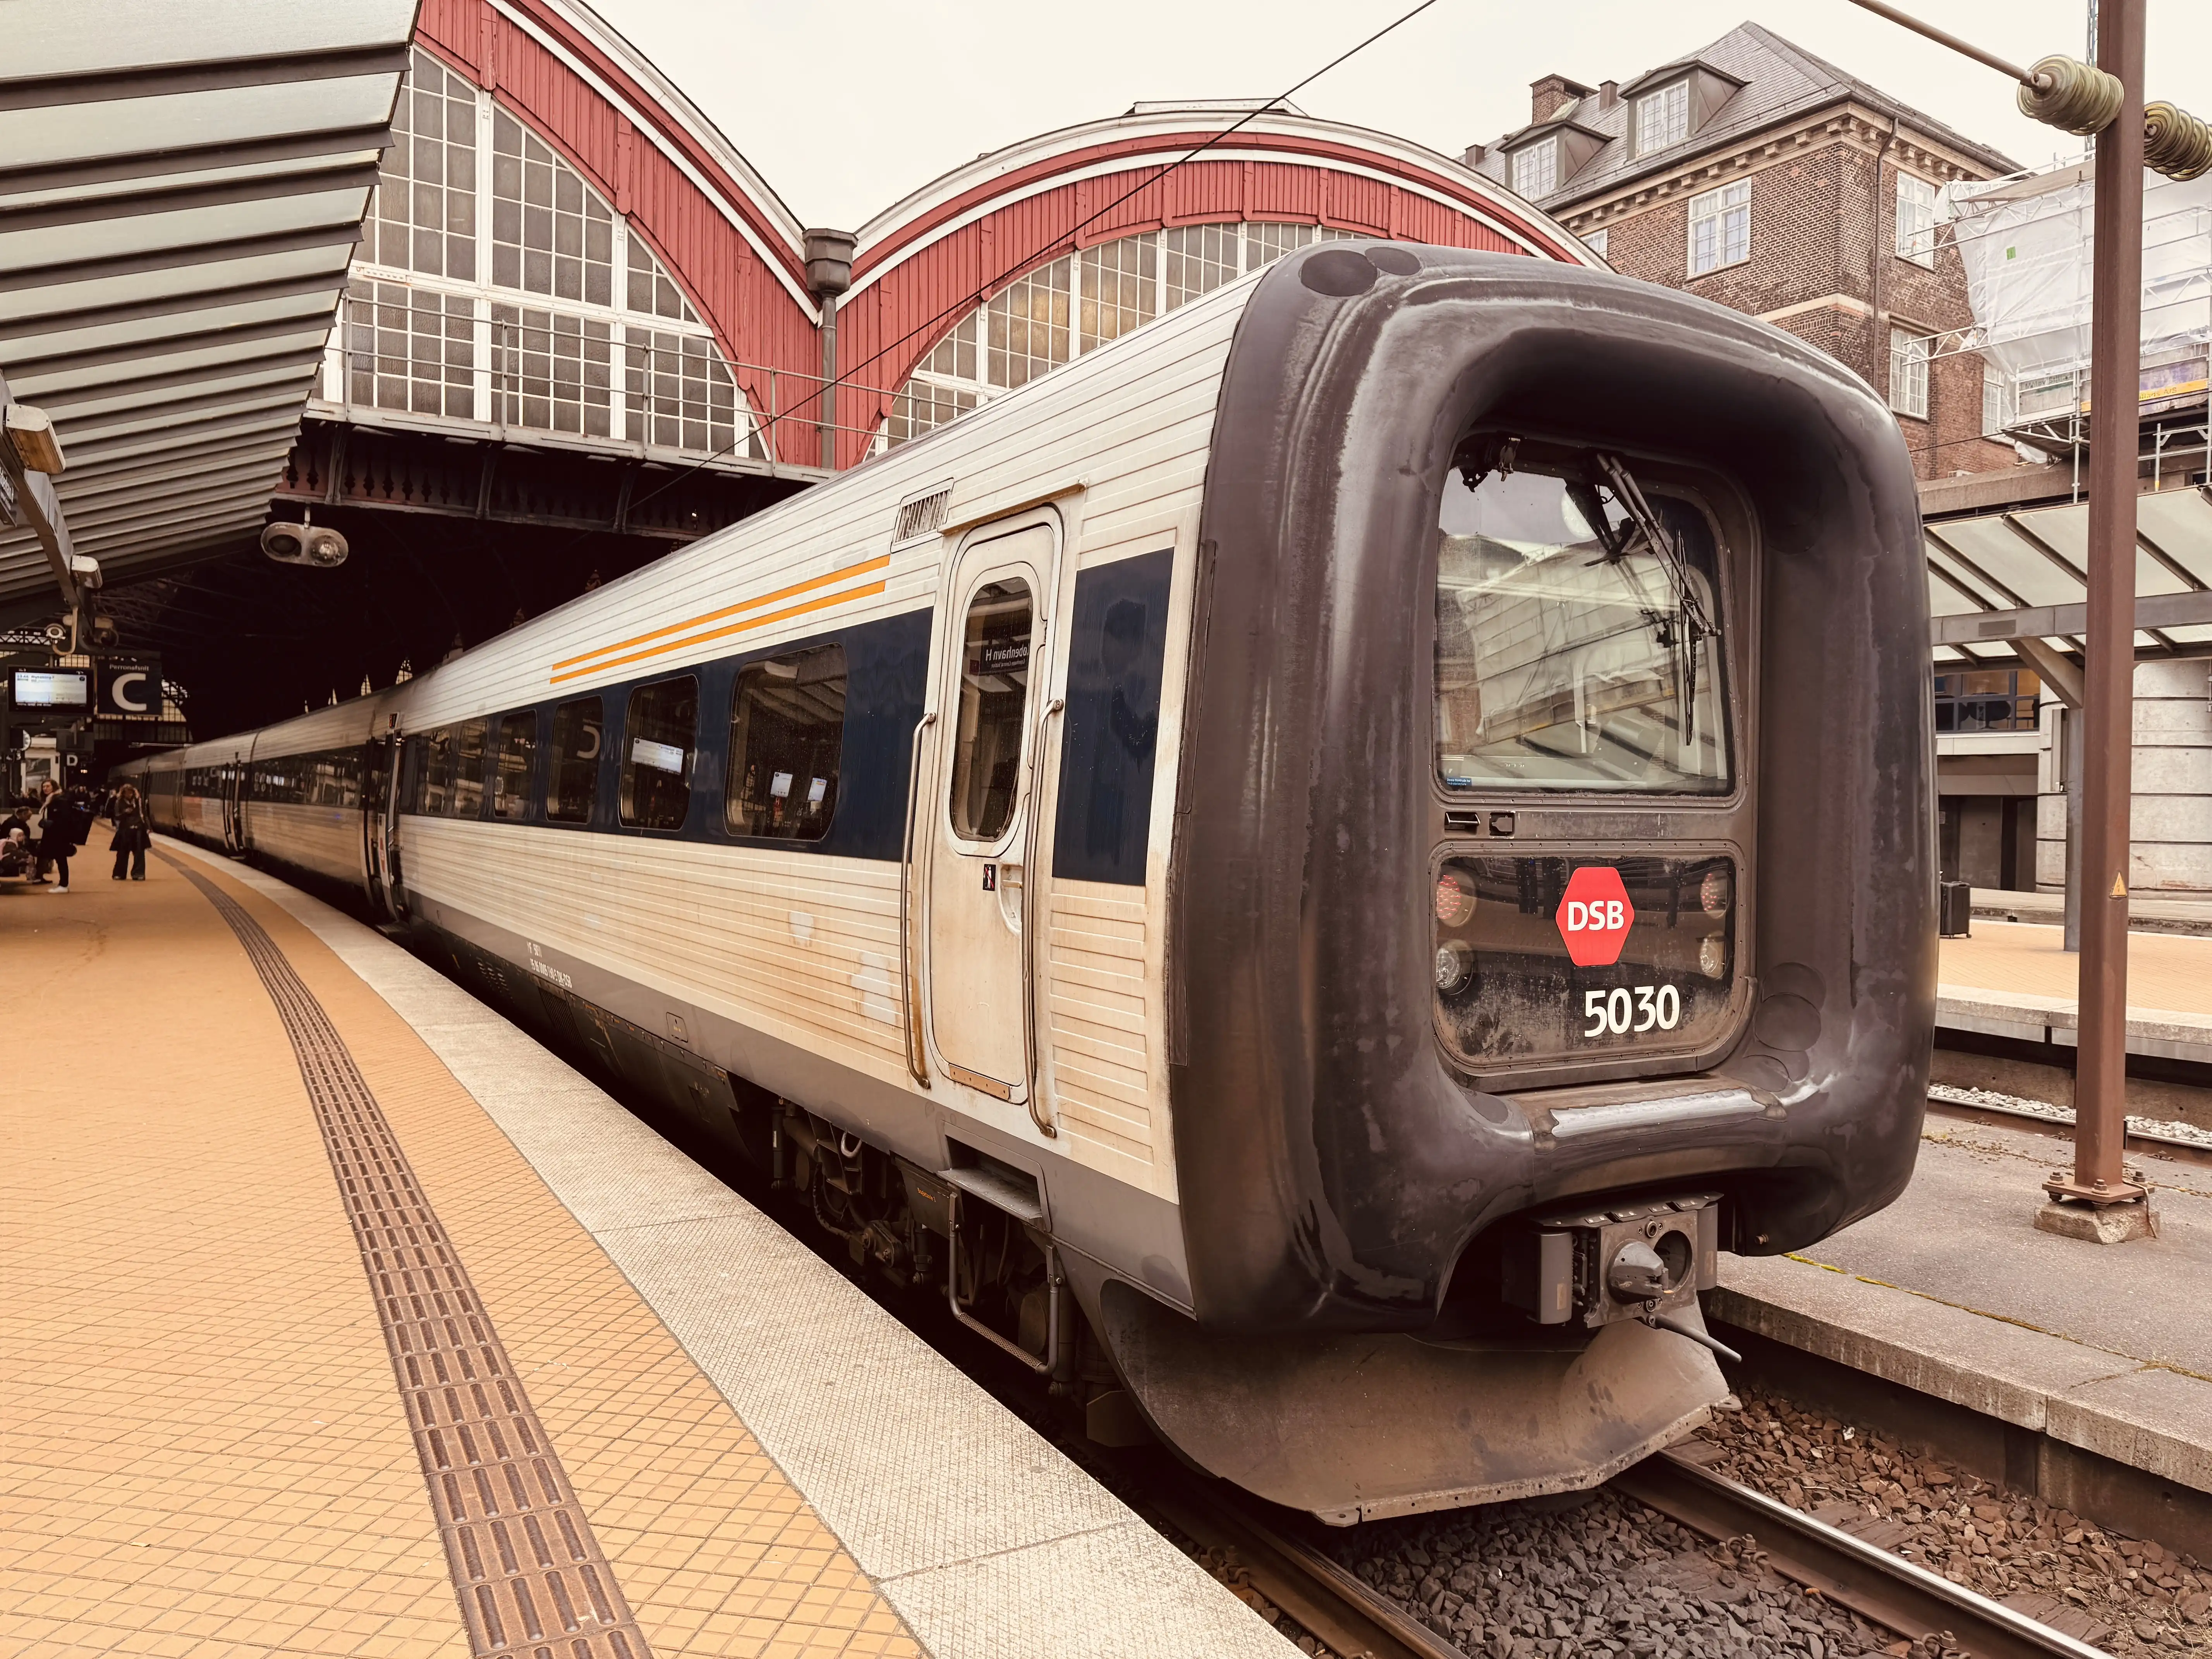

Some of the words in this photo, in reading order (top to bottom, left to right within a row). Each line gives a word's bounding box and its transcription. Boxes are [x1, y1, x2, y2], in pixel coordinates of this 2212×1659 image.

[112, 673, 147, 711] C
[67, 755, 77, 767] D
[1568, 900, 1625, 931] DSB
[1584, 984, 1680, 1038] 5030
